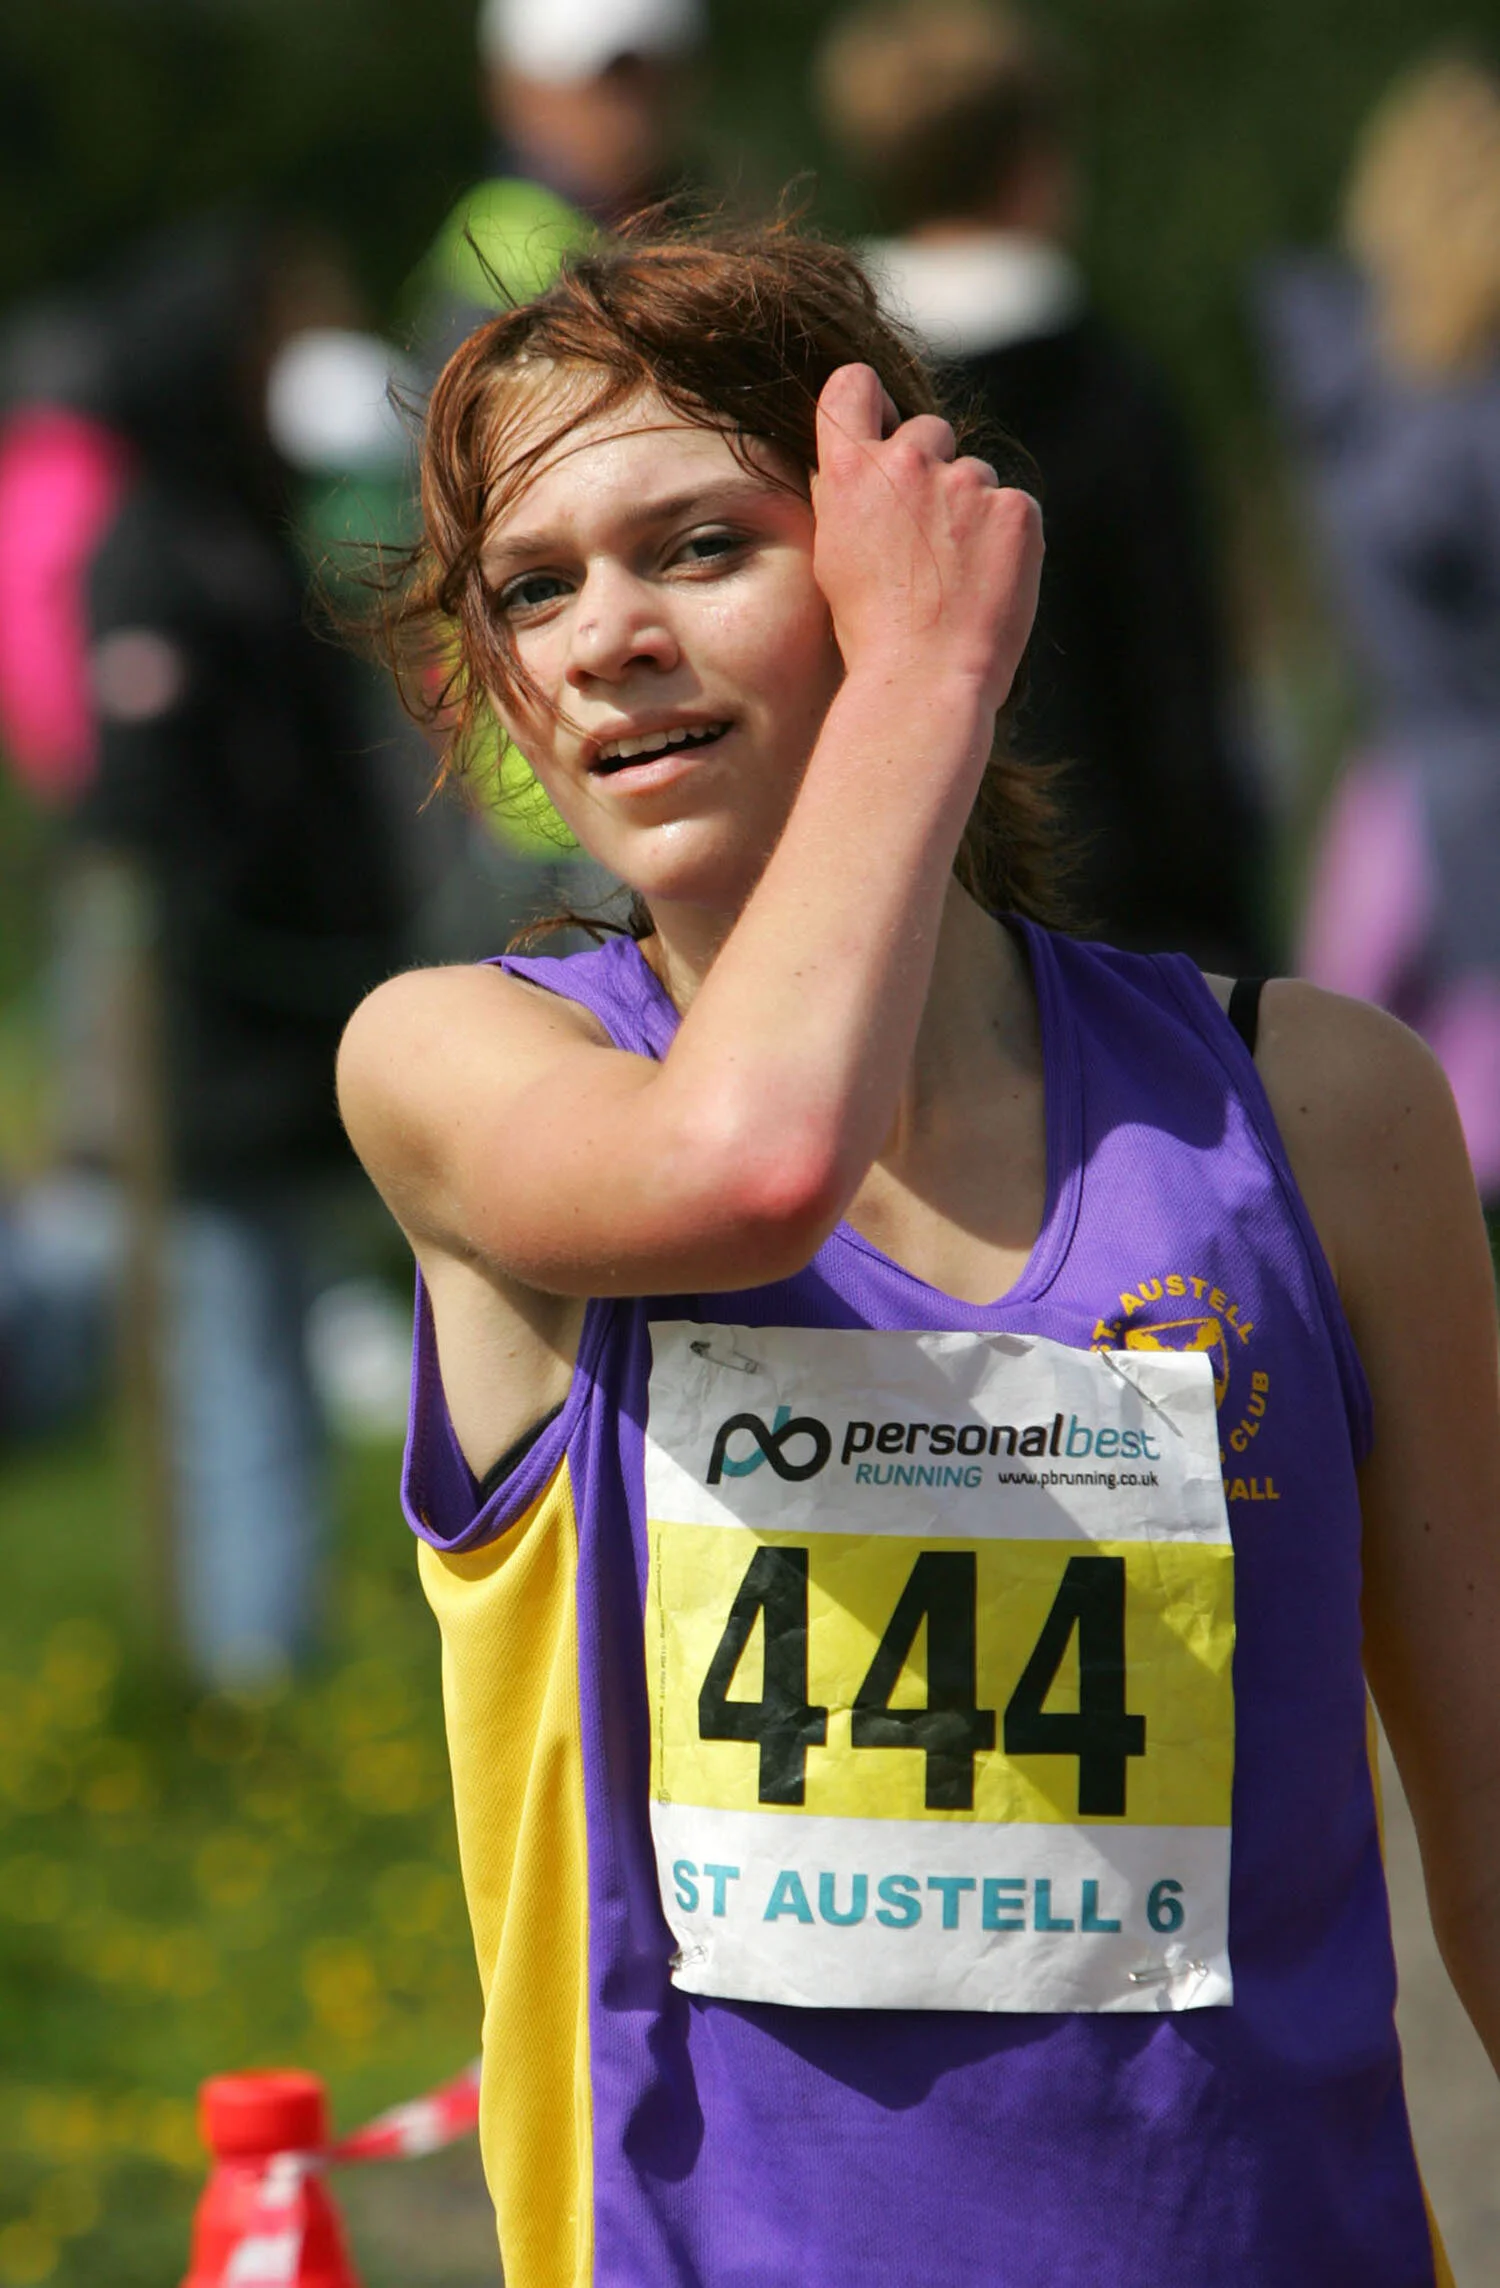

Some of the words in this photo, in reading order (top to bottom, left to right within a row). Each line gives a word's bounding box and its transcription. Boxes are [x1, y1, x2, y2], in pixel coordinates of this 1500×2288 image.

[1119, 1274, 1254, 1344] AUSTELL
[1229, 1371, 1269, 1452] CLUB
[856, 1464, 982, 1488] RUNNING
[998, 1470, 1159, 1489] www.pbrunning.co.uk
[699, 1546, 1145, 1815] 444
[673, 1860, 739, 1916] ST
[763, 1870, 1122, 1933] AUSTELL
[1147, 1880, 1184, 1933] 6
